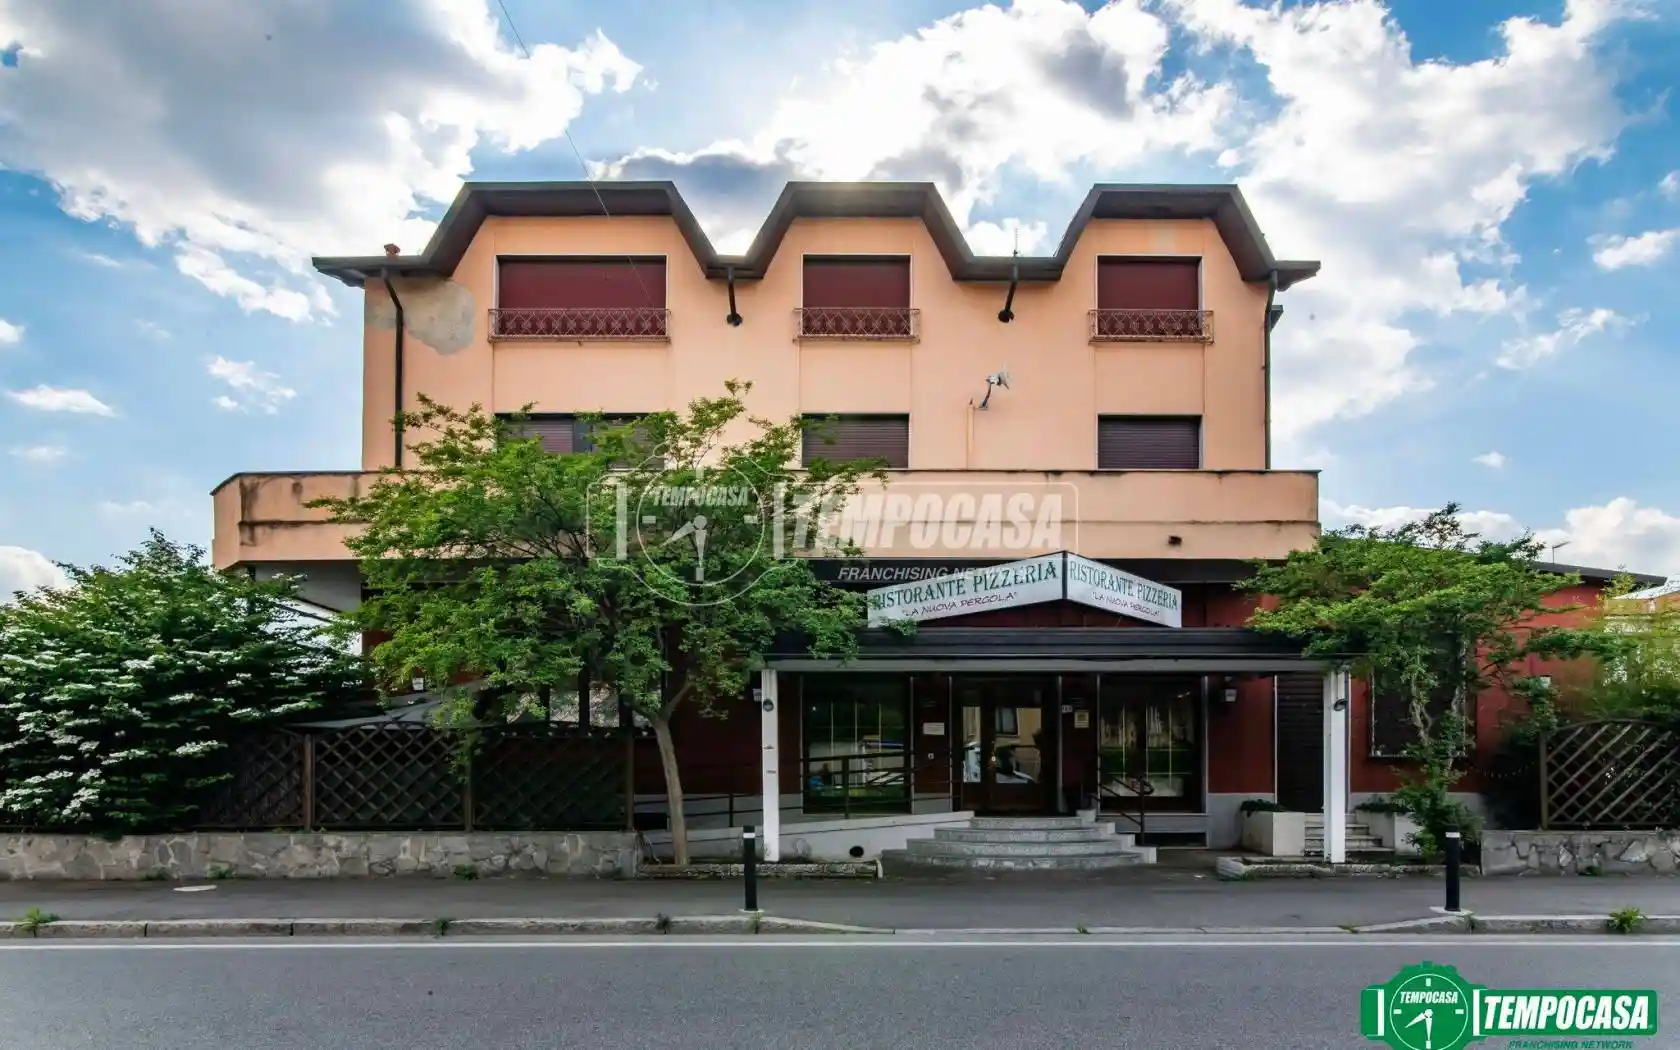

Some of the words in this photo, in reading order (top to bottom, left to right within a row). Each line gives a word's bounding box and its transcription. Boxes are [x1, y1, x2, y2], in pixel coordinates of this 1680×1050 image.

[872, 578, 967, 610] RISTORANTE
[973, 560, 1058, 592] PIZZERIA
[921, 602, 957, 616] NUOVA
[1069, 560, 1134, 597] RISTORANTE
[1137, 583, 1178, 611] PIZZERIA
